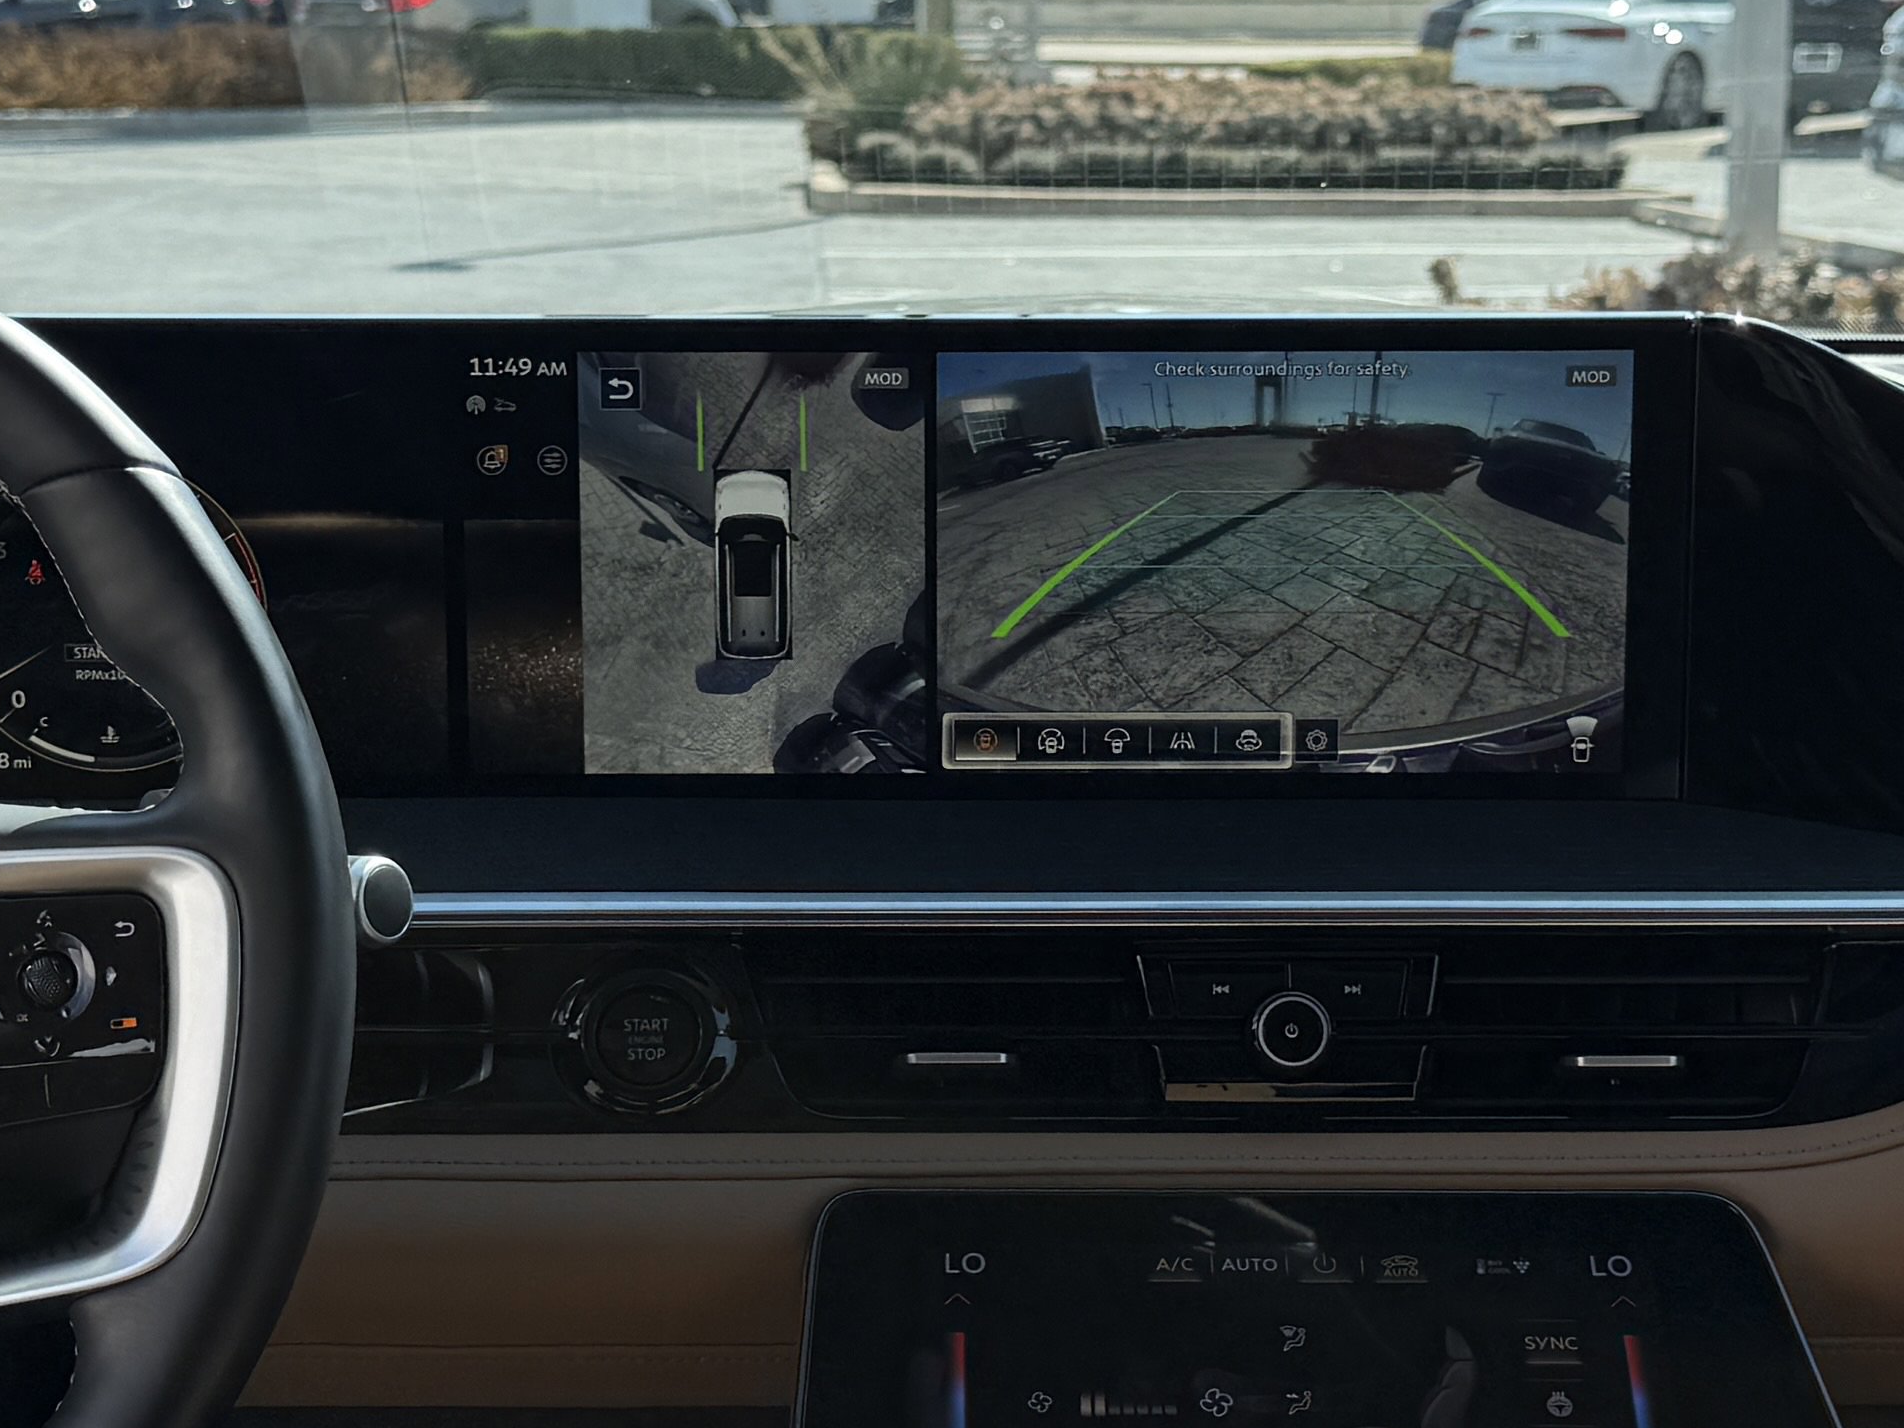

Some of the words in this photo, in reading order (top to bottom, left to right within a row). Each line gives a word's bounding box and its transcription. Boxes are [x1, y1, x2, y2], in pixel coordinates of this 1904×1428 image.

[469, 357, 532, 377] 11:49
[537, 361, 568, 377] AM
[1154, 360, 1205, 377] Check
[1210, 360, 1322, 380] surroundings
[1327, 360, 1354, 377] for
[865, 372, 903, 386] MOD
[1572, 370, 1610, 384] MOD
[11, 690, 26, 709] 0
[14, 754, 32, 770] mi
[623, 1018, 670, 1032] START
[627, 1047, 667, 1061] STOP
[944, 1252, 986, 1275] LO
[1156, 1256, 1194, 1272] A/C
[1221, 1257, 1279, 1272] AUTO
[1589, 1255, 1633, 1277] LO
[1383, 1268, 1419, 1278] AUTO
[1524, 1335, 1580, 1352] SYNC
